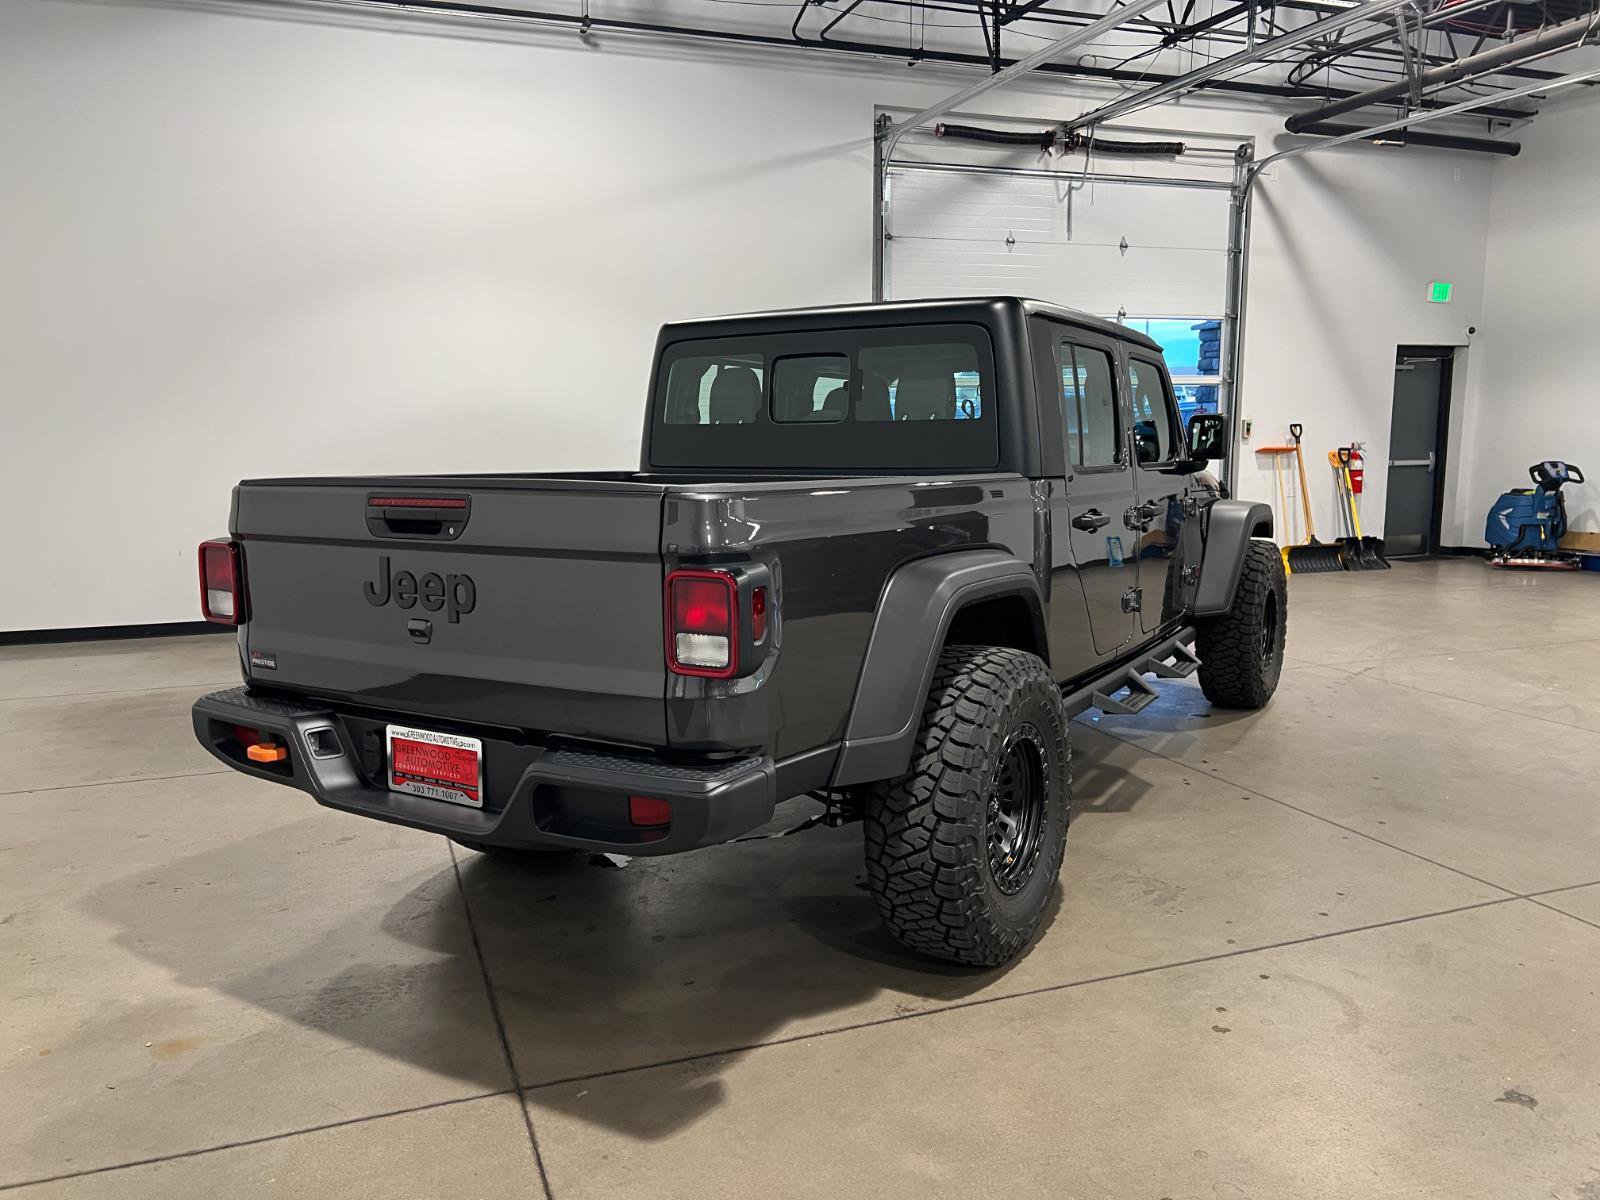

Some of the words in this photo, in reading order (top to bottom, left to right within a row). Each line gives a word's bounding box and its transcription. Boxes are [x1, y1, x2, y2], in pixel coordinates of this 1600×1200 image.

[363, 555, 477, 624] Jeep
[395, 743, 451, 761] GREENWOOD
[405, 755, 461, 771] AUTOMOTIVE
